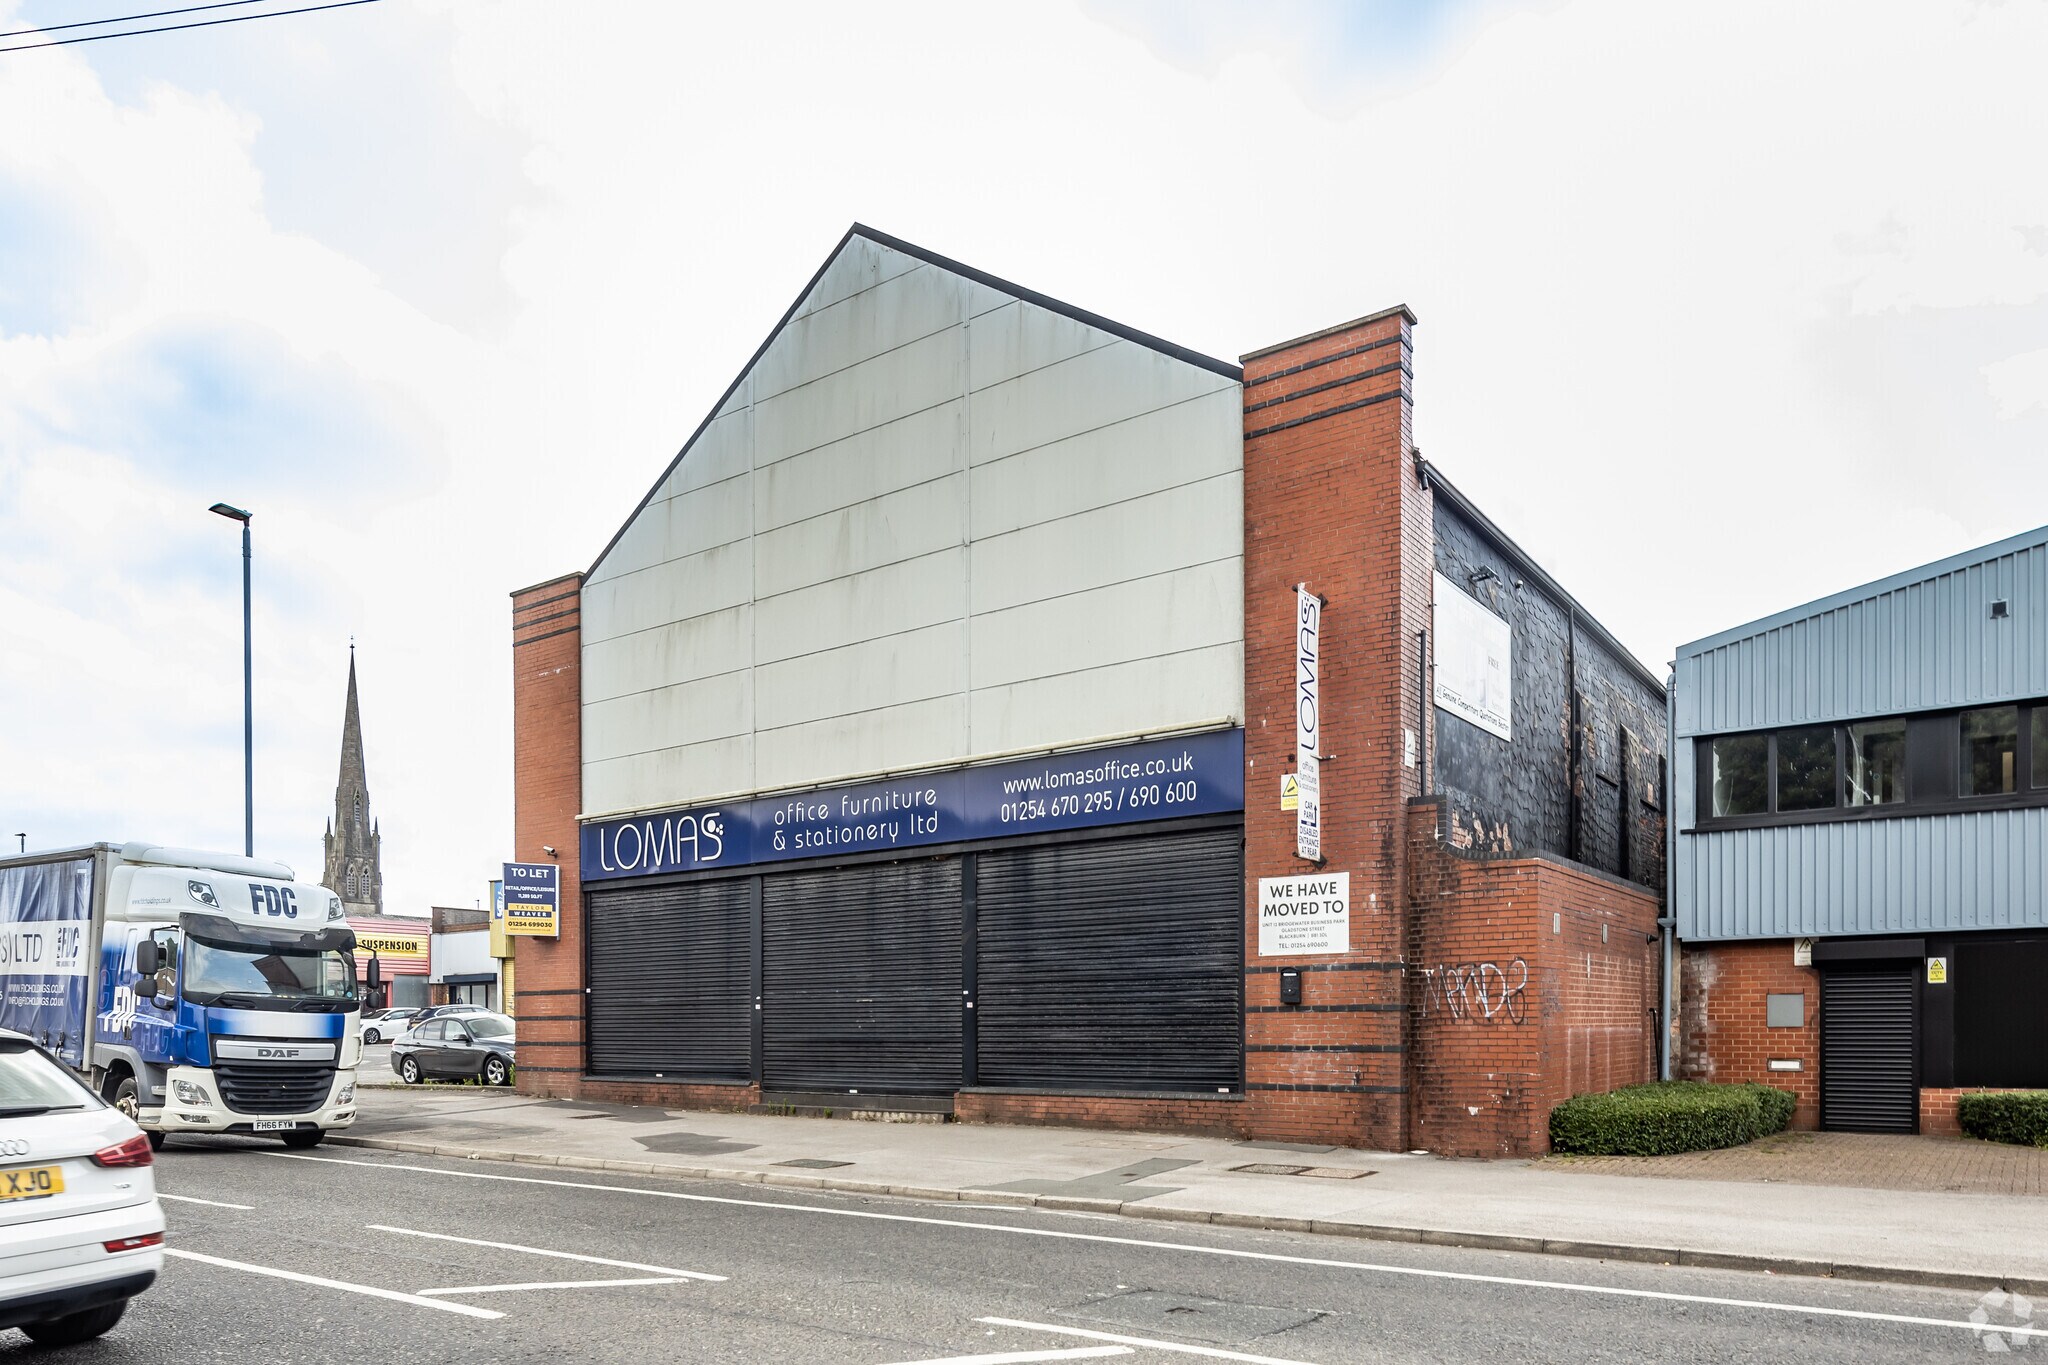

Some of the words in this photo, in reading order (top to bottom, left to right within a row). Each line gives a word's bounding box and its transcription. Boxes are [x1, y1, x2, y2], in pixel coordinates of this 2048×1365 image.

[1300, 597, 1317, 751] LOMAS
[1003, 750, 1194, 794] www.lomasoffice.co.uk
[774, 800, 829, 826] office
[841, 788, 937, 816] furniture
[1001, 800, 1046, 823] 01254
[1051, 795, 1079, 817] 670
[1084, 790, 1113, 813] 295
[1117, 786, 1126, 811] /
[1129, 785, 1160, 808] 690
[1165, 780, 1197, 803] 600
[1304, 800, 1313, 810] CAR
[1304, 810, 1314, 820] PARK
[773, 830, 786, 851] &
[795, 820, 900, 848] stationery
[910, 811, 939, 836] ltd
[1300, 826, 1318, 838] DISABLED
[600, 811, 725, 872] LOMAS
[1298, 836, 1319, 848] ENTRANCE
[1302, 846, 1308, 855] AT
[1308, 848, 1317, 857] REAR
[511, 868, 527, 877] TO
[530, 869, 549, 878] LET
[1270, 884, 1293, 898] WE
[1298, 882, 1337, 897] HAVE
[248, 883, 298, 919] FDC
[1264, 902, 1320, 917] MOVED
[1323, 900, 1344, 914] TO
[15, 933, 43, 963] LTD
[61, 927, 80, 959] FDC
[361, 939, 418, 951] SUSPENSION
[257, 1048, 300, 1058] DAF
[256, 1121, 277, 1130] FH66
